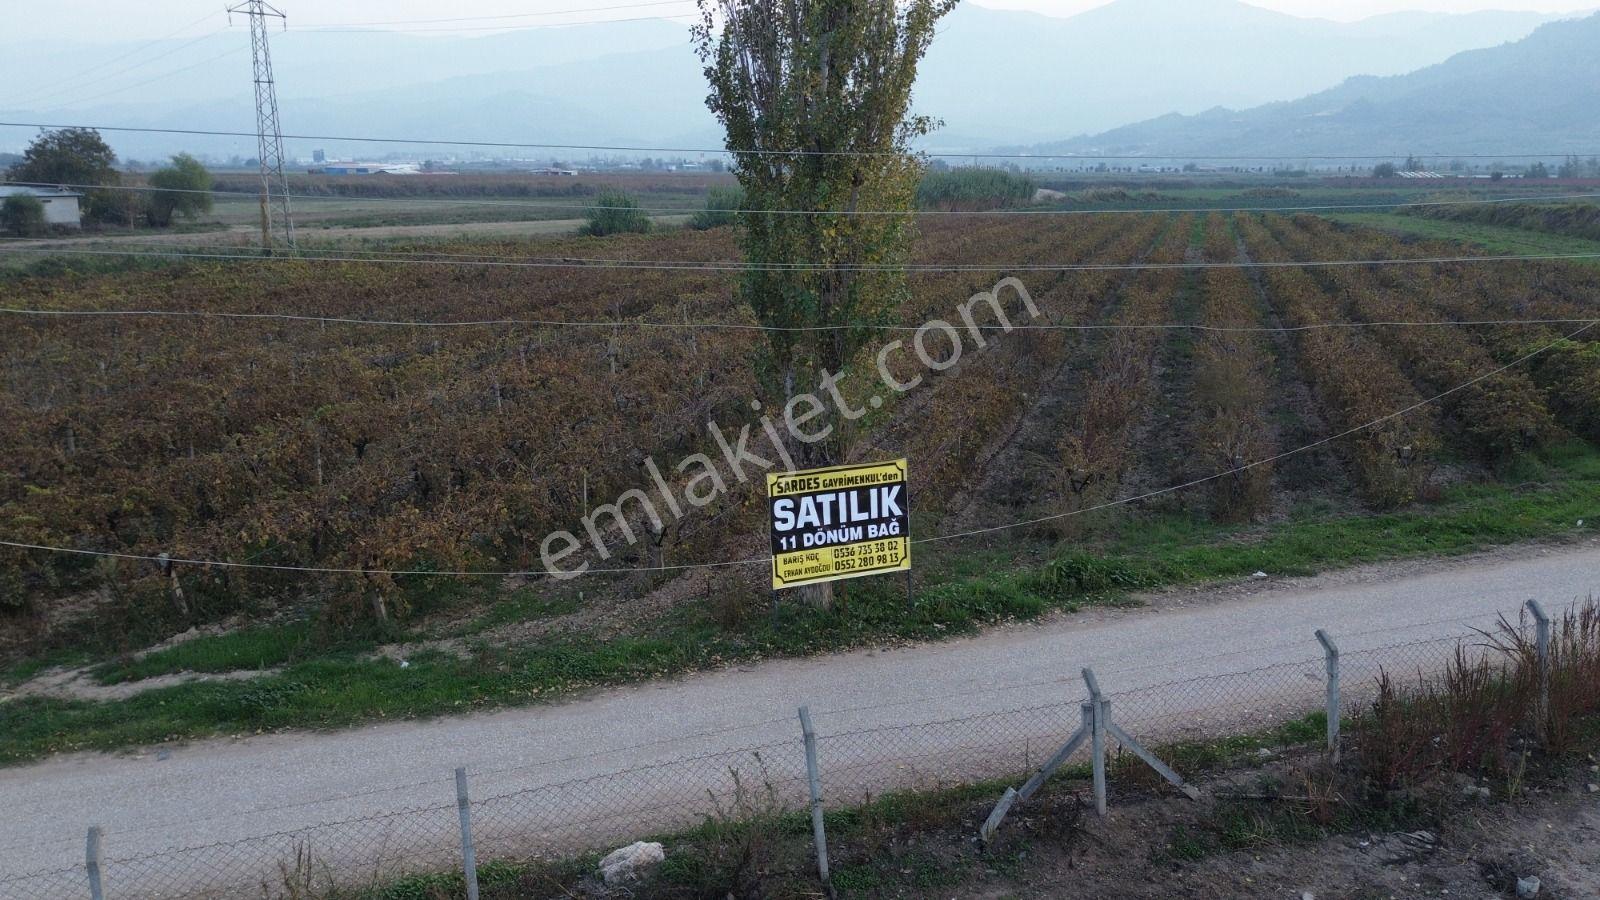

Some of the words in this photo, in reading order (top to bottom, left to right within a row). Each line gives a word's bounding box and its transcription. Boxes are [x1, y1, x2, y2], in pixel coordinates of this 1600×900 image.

[777, 477, 820, 494] SARDES
[774, 485, 903, 532] SATILIK
[780, 535, 797, 550] 11
[803, 525, 863, 547] DÖNÜM
[868, 518, 900, 537] BAĞ
[834, 547, 855, 559] 0536
[858, 544, 873, 555] 735
[875, 542, 885, 553] 38
[888, 540, 898, 551] 02
[835, 558, 856, 571] 0552
[858, 556, 874, 568] 280
[877, 554, 887, 564] 98
[890, 552, 899, 562] 13
[784, 568, 803, 578] ERKAN
